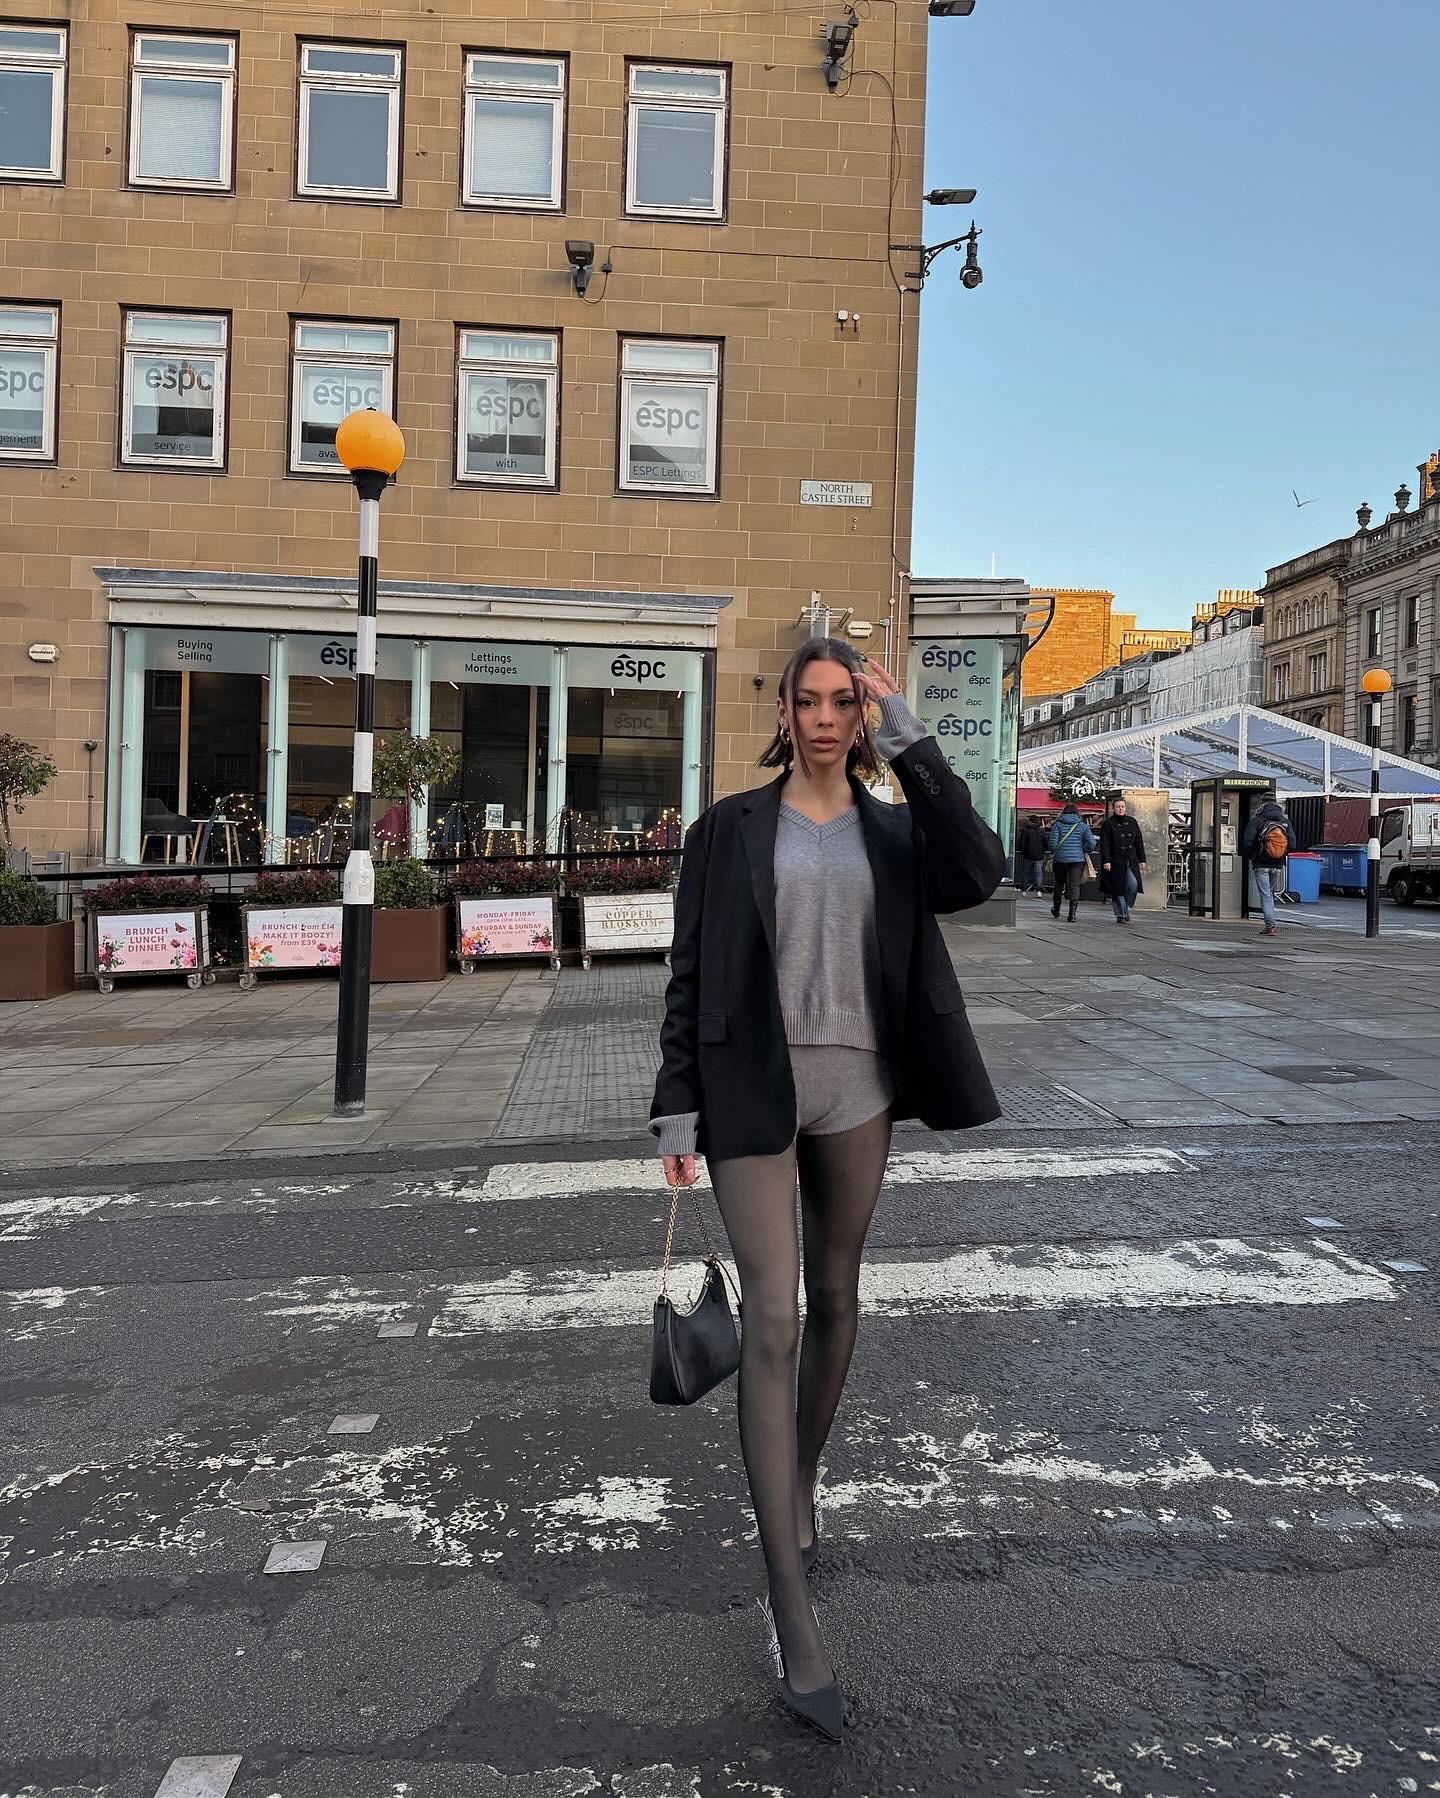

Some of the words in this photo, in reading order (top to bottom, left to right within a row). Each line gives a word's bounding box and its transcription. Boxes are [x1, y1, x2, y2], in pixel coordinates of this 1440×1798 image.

[154, 440, 191, 451] service
[495, 458, 518, 469] with
[633, 465, 660, 477] ESPC
[661, 466, 702, 481] Lettings
[820, 484, 854, 494] NORTH
[801, 493, 836, 503] CASTLE
[837, 494, 872, 505] STREET
[177, 639, 213, 652] Buying
[177, 651, 212, 664] Selling
[471, 652, 512, 664] Lettings
[464, 663, 518, 676] Mortgages
[605, 910, 653, 919] COPPER
[262, 923, 298, 931] BRUNCH
[515, 923, 542, 931] SUNDAY
[602, 919, 657, 929] BLOSSOM
[125, 927, 169, 936] BRUNCH
[301, 931, 334, 939] BOOZY!
[130, 936, 165, 944] LUNCH
[128, 944, 167, 953] DINNER
